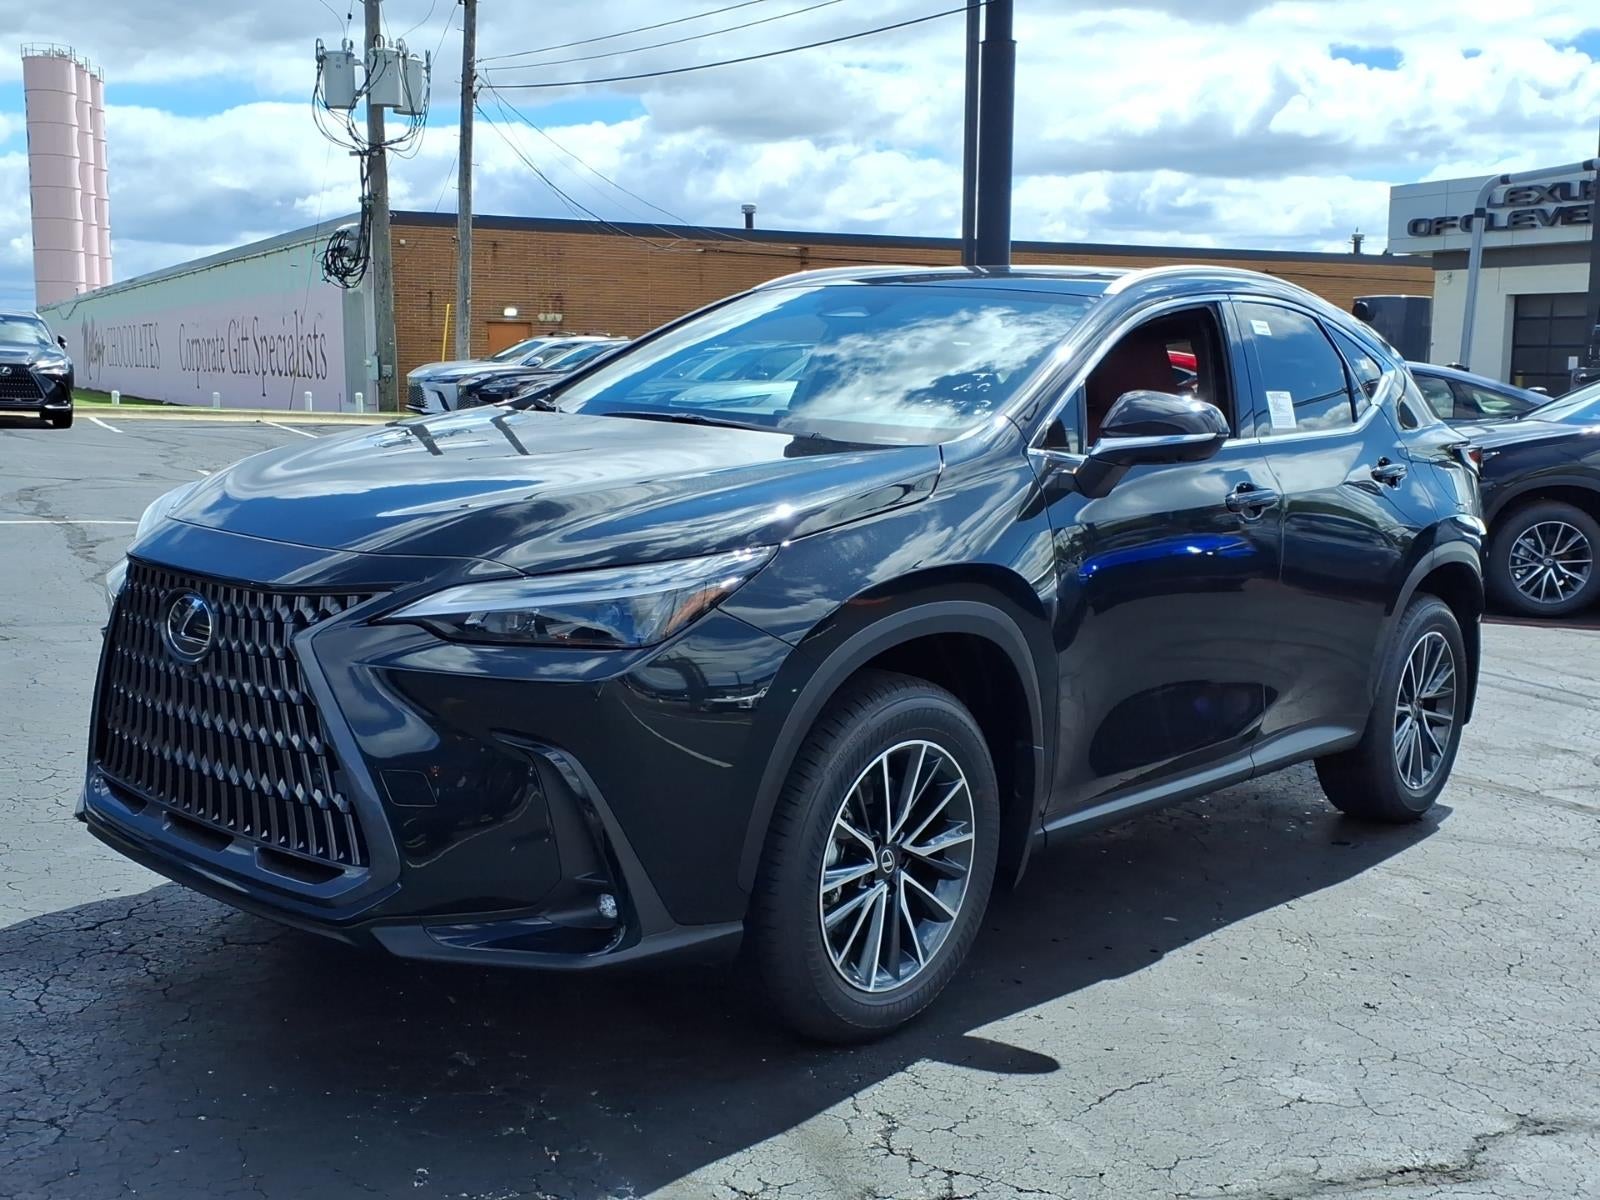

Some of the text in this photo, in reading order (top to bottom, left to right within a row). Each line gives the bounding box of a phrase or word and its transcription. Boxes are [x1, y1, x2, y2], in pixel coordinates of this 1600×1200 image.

[1407, 216, 1458, 237] OF
[179, 323, 225, 389] Corporate
[227, 316, 250, 375] Gift
[252, 309, 327, 397] Specialists
